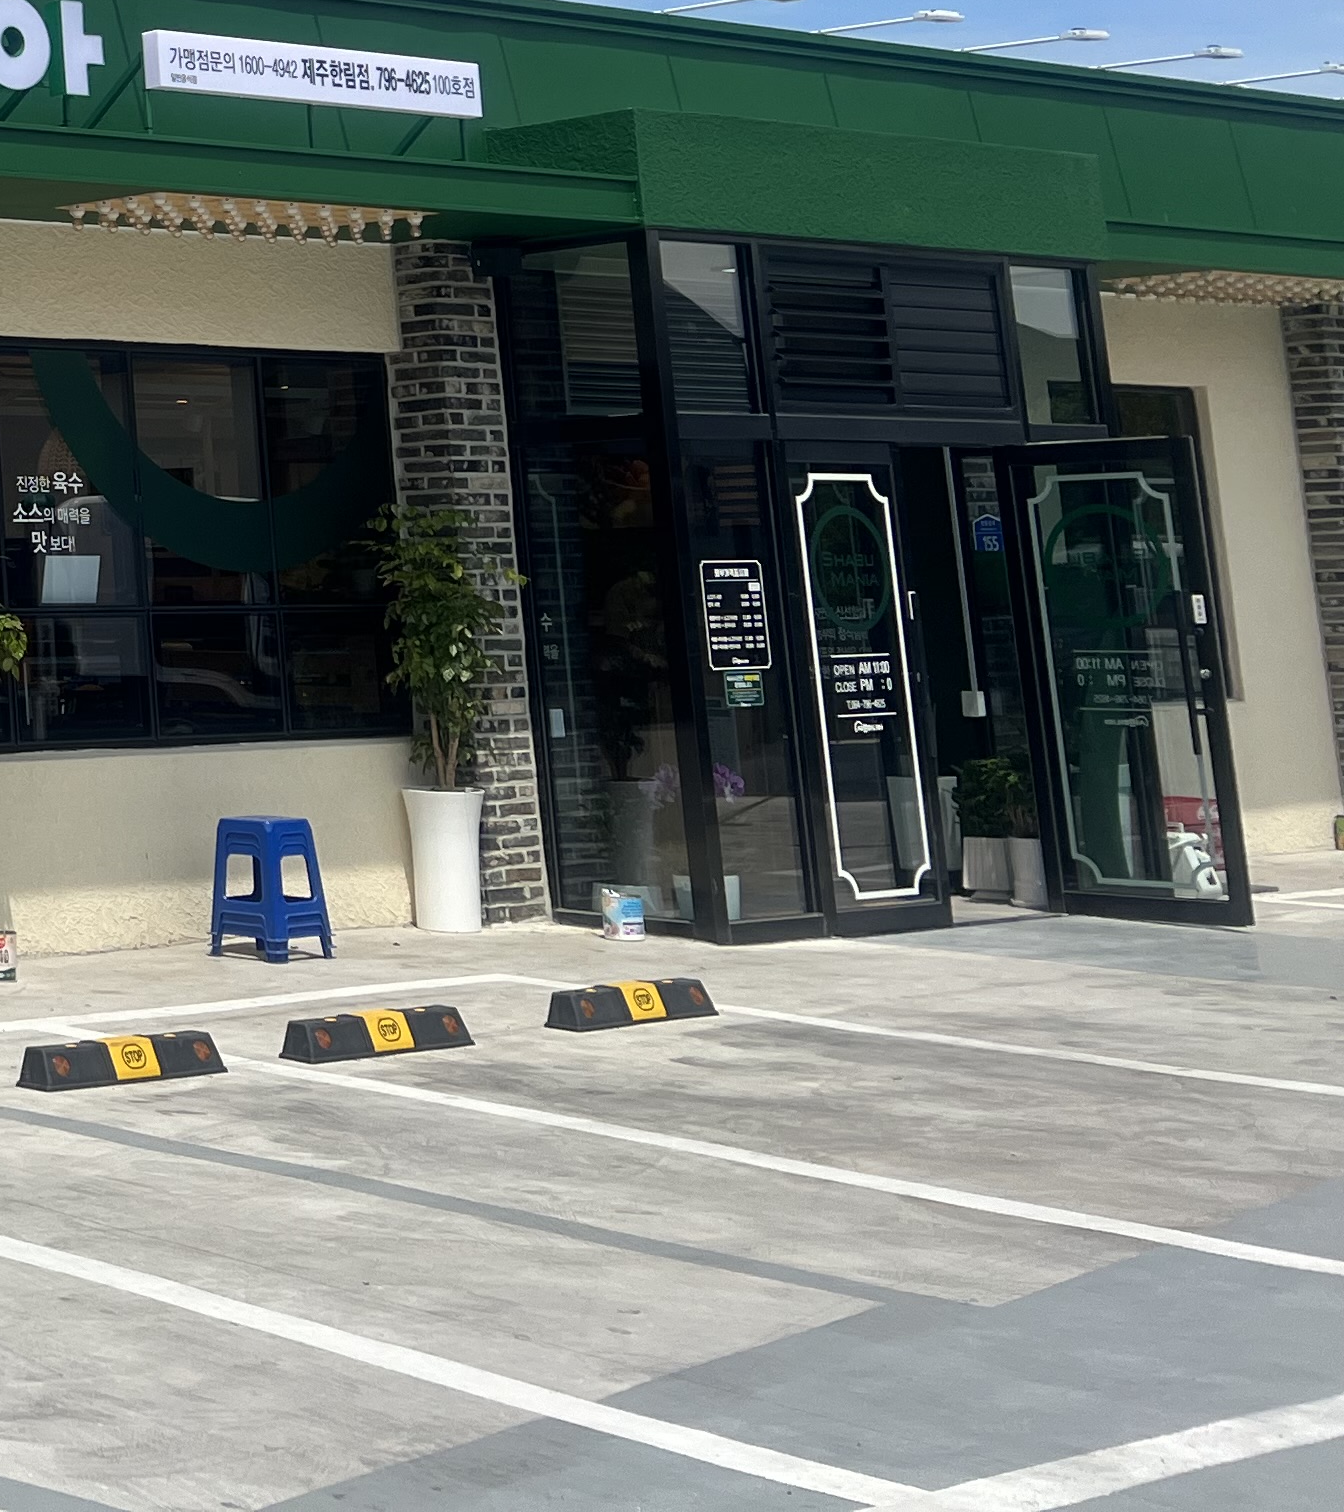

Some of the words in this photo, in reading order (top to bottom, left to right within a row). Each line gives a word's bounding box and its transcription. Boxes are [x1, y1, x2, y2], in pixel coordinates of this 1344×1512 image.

[169, 47, 236, 73] 가맹점문의
[239, 55, 298, 79] 1600-4942
[376, 66, 431, 95] 796-4625
[432, 74, 475, 99] 100호점
[16, 475, 50, 493] 진정한
[52, 471, 84, 495] 육수
[12, 503, 55, 524] 소스의
[57, 507, 91, 525] 매력을
[31, 530, 47, 554] 맛
[834, 664, 855, 676] OPEN
[835, 681, 857, 693] CLOSE
